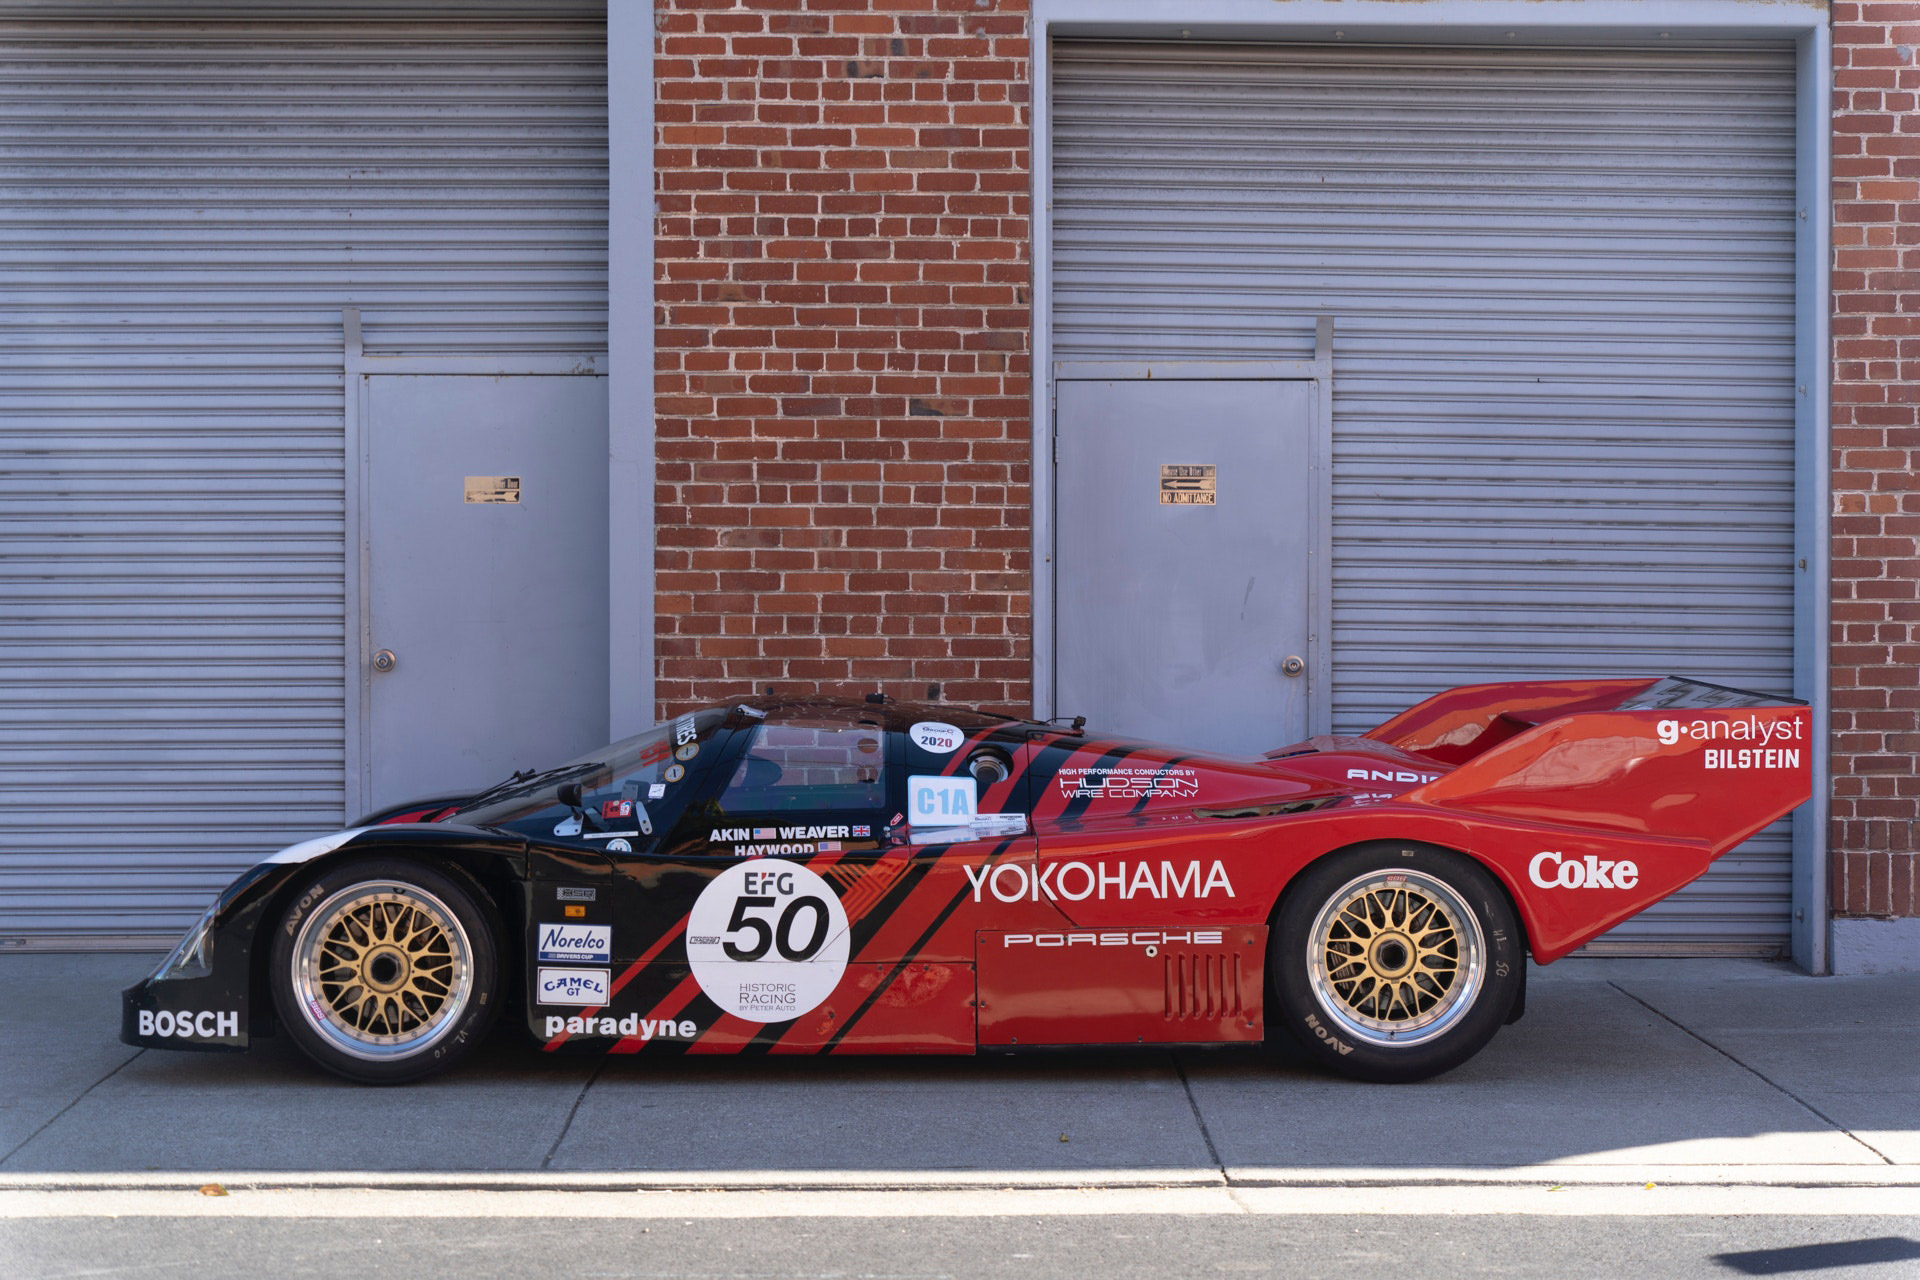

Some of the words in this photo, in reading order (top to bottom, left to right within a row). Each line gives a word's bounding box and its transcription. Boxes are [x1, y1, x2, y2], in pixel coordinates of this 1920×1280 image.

[1162, 492, 1172, 503] NO
[1173, 492, 1214, 503] ADMITTANCE
[921, 735, 953, 748] 2020
[1704, 748, 1800, 769] BILSTEIN
[1134, 768, 1185, 776] CONDUCTORS
[1059, 777, 1199, 789] HUDSON
[917, 787, 969, 816] C1A
[1061, 789, 1105, 798] WIRE
[1109, 789, 1199, 798] COMPANY
[709, 828, 750, 842] AKIN
[779, 825, 850, 840] WEAVER
[734, 844, 815, 857] HAYWOOD
[1528, 851, 1639, 890] Coke
[744, 872, 794, 896] EFG
[962, 859, 1236, 903] YOKOHAMA
[285, 883, 326, 937] AVON
[722, 895, 830, 963] 50
[541, 925, 605, 951] Norelco
[1004, 931, 1223, 948] PORSCHE
[543, 977, 604, 994] CAMEL
[566, 987, 581, 996] GT
[739, 983, 797, 992] HISTORIC
[739, 992, 797, 1004] RACING
[139, 1010, 239, 1038] BOSCH
[545, 1012, 697, 1041] paradyne
[1304, 1013, 1355, 1056] AVON
